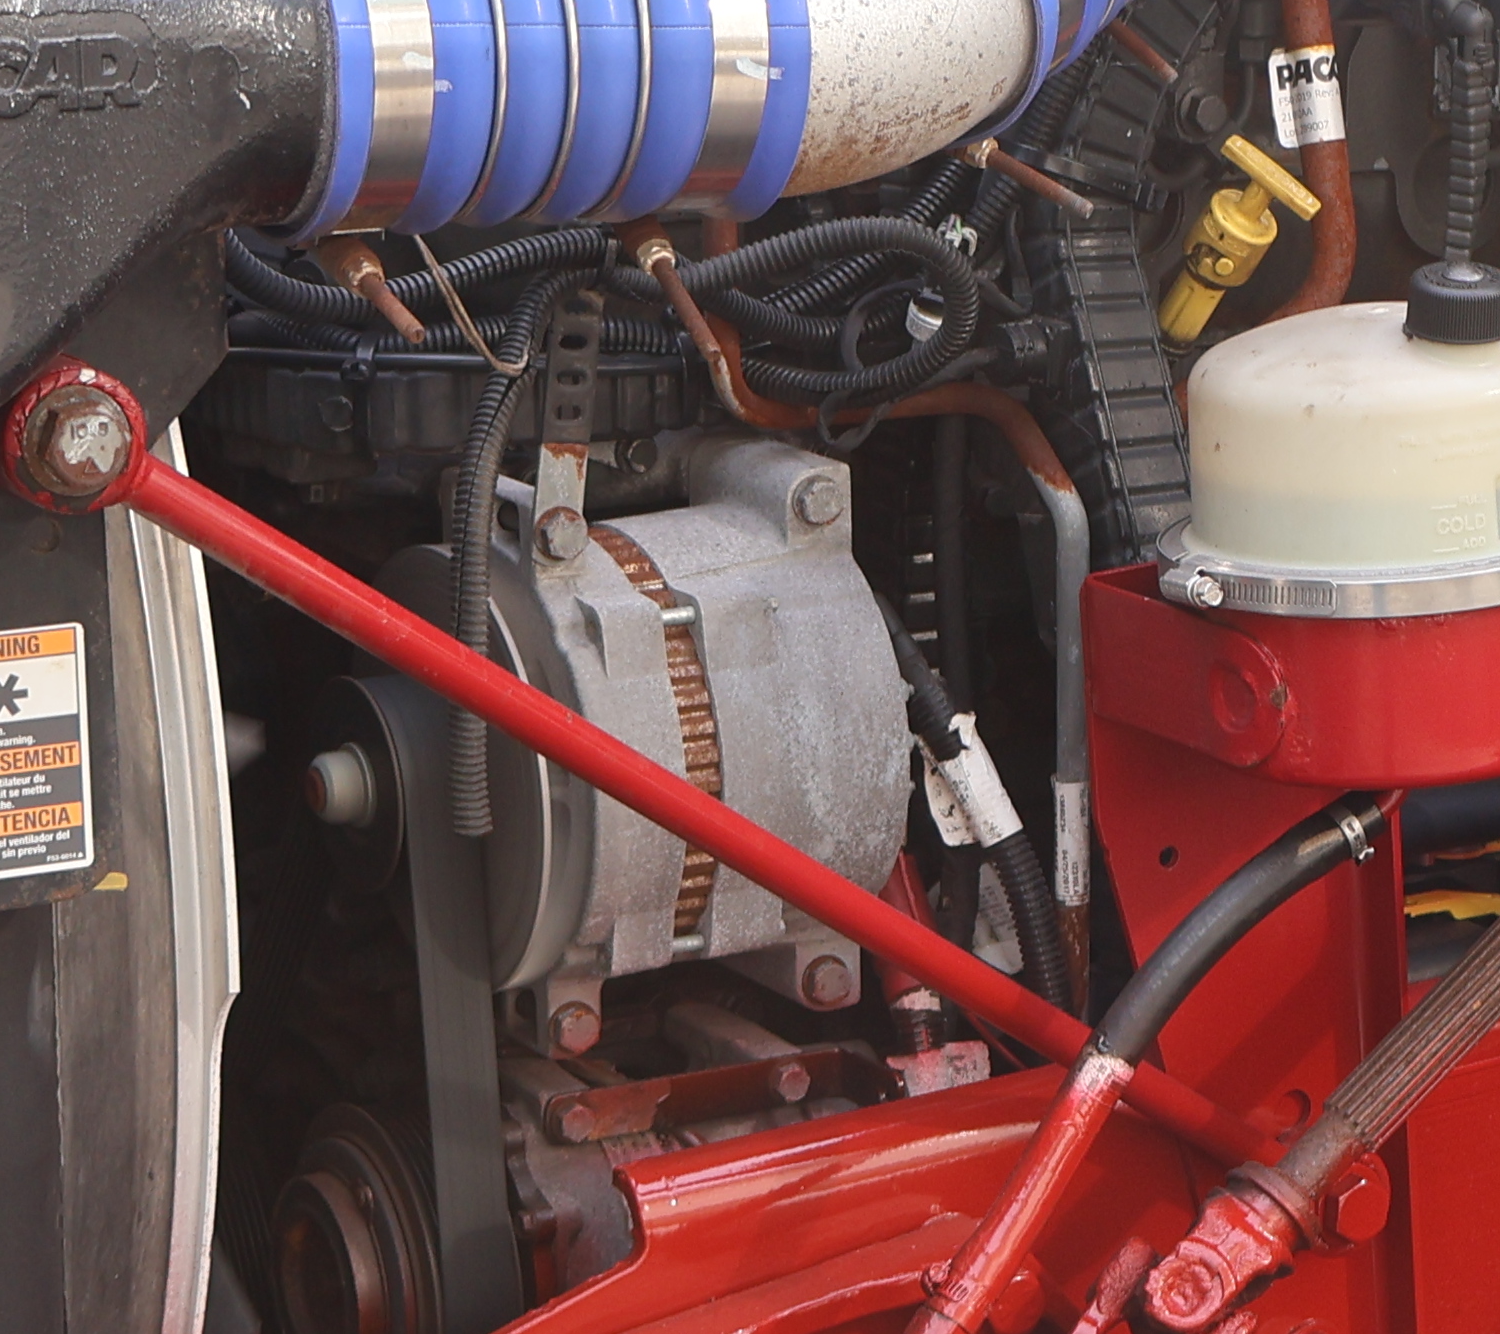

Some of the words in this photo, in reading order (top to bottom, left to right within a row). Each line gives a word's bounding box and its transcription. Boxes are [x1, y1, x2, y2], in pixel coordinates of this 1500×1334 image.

[1436, 512, 1487, 536] COLD
[1462, 535, 1487, 549] ADD
[33, 774, 46, 785] du
[8, 789, 20, 798] se
[22, 784, 52, 797] mettre
[8, 833, 54, 847] ventilador
[56, 829, 70, 840] del
[1, 848, 16, 859] sin
[17, 845, 46, 859] previo
